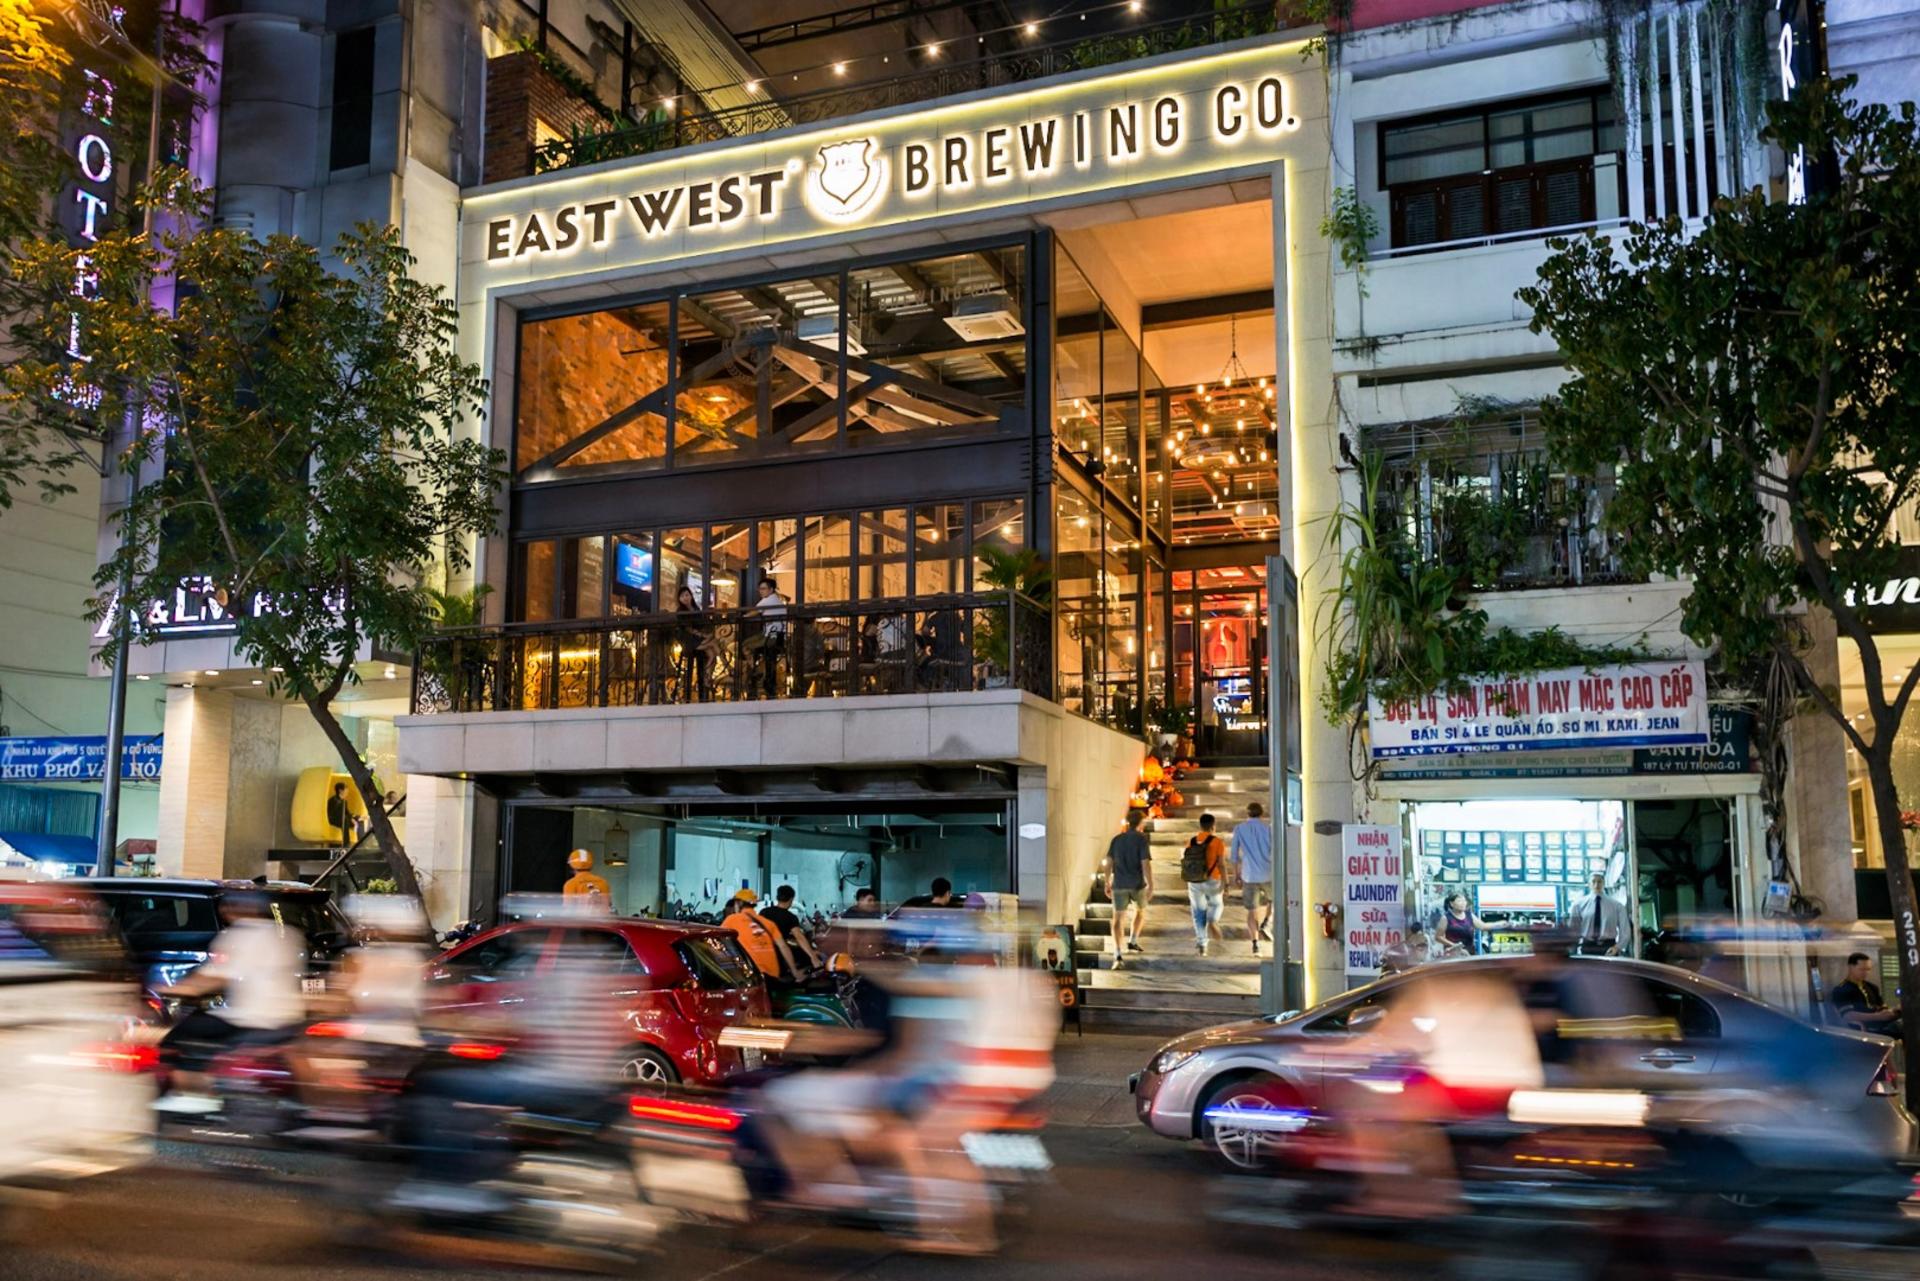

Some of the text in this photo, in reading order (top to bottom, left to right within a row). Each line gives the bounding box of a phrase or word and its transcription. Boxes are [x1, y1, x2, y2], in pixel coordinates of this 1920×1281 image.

[488, 77, 1295, 261] EAST WEST BREWING CO.
[1536, 680, 1571, 714] MAY
[1578, 673, 1614, 715] MẶC
[1620, 676, 1655, 711] CAO
[1660, 665, 1694, 709] CẤP
[1462, 729, 1470, 738] &
[1648, 716, 1680, 731] JEAN
[2, 763, 38, 778] KHU
[1357, 829, 1389, 848] NHẬN
[1348, 852, 1380, 881] GIẶT
[1348, 884, 1399, 902] LAUNDRY
[1348, 950, 1371, 968] REPAIR
